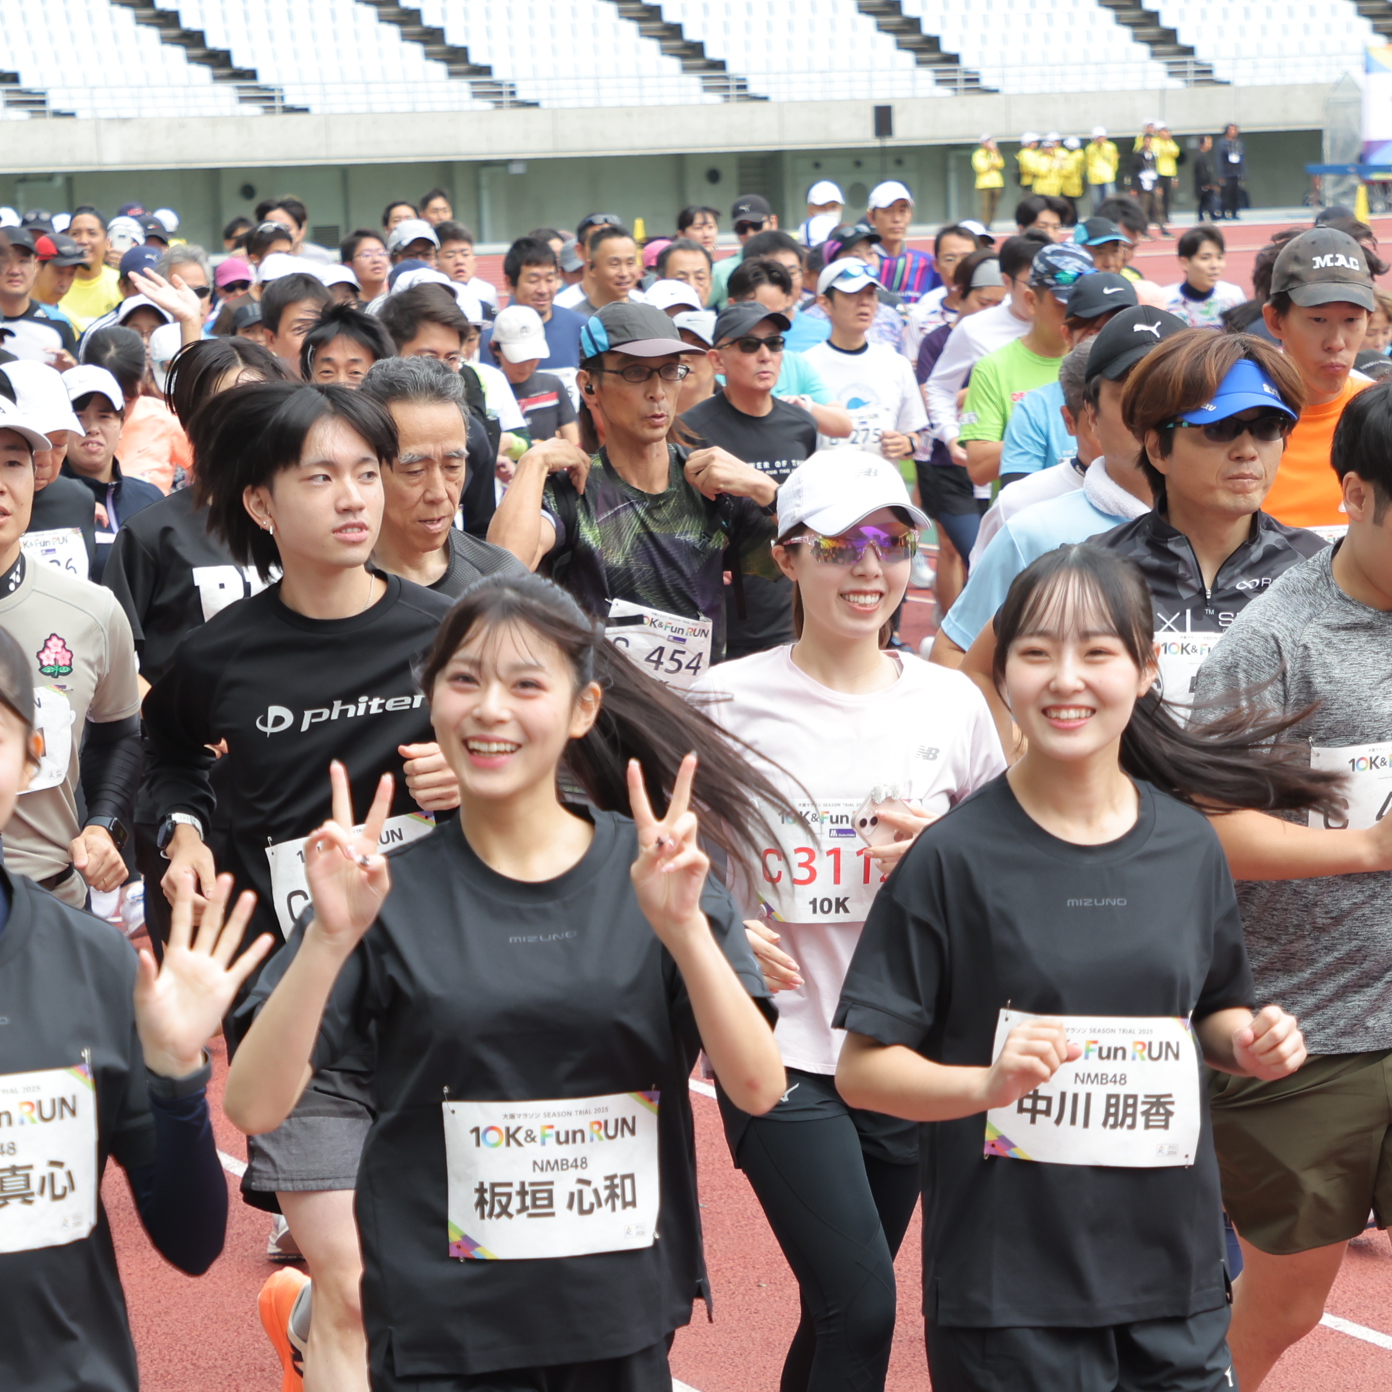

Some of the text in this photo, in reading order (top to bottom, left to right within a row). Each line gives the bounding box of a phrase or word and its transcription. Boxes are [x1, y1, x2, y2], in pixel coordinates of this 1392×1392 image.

[1312, 253, 1360, 271] MAC
[642, 616, 685, 635] 0K&Fun
[686, 627, 710, 638] RUN
[644, 645, 704, 676] 454
[762, 847, 887, 886] C 311
[809, 897, 851, 915] 10K
[1066, 896, 1127, 908] MIZUNO
[508, 929, 578, 945] MIZUNO
[1084, 1040, 1180, 1061] Fun RUN
[1074, 1072, 1128, 1086] NMB48
[18, 1095, 78, 1126] RUN
[502, 1106, 609, 1120] 大阪マラソン SEASON TRIAL 2025
[1016, 1090, 1176, 1131] 中川 朋香
[469, 1115, 637, 1149] 10K&Fun RUN
[532, 1157, 589, 1174] NMB48
[474, 1172, 638, 1221] 板垣 心和
